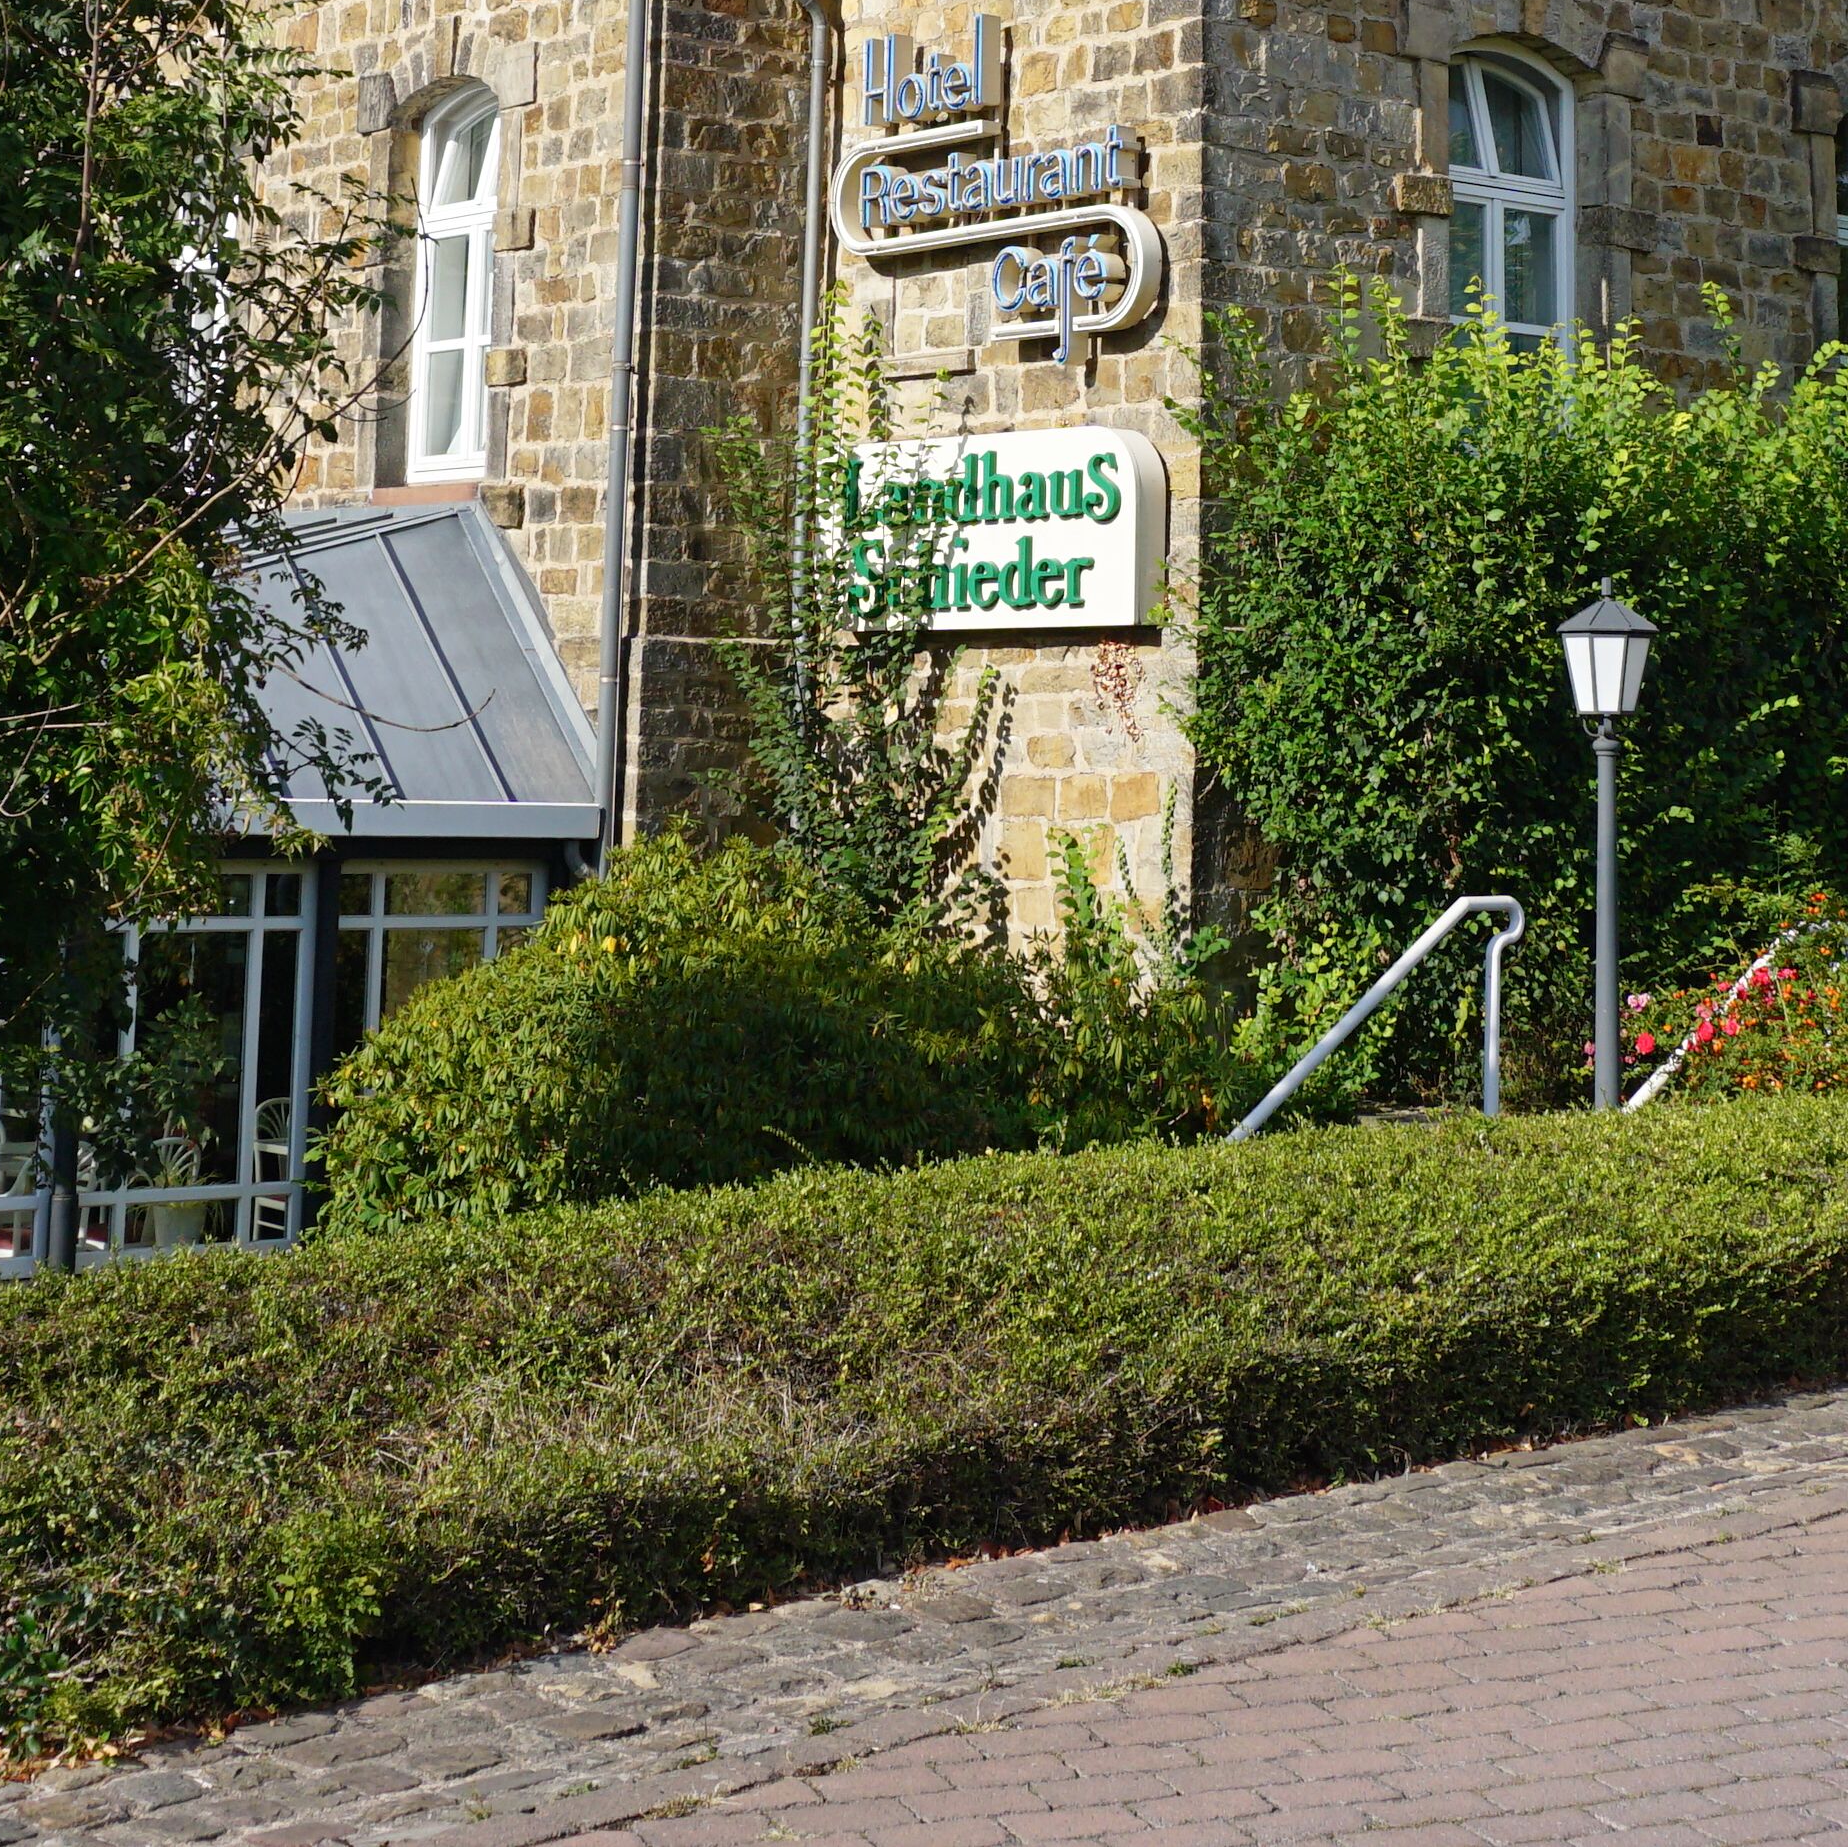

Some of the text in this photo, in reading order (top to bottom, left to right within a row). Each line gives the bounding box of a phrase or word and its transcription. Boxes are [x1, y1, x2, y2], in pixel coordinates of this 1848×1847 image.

[863, 13, 988, 127] Hotel
[859, 123, 1126, 229] Restaurant
[991, 233, 1109, 366] Café
